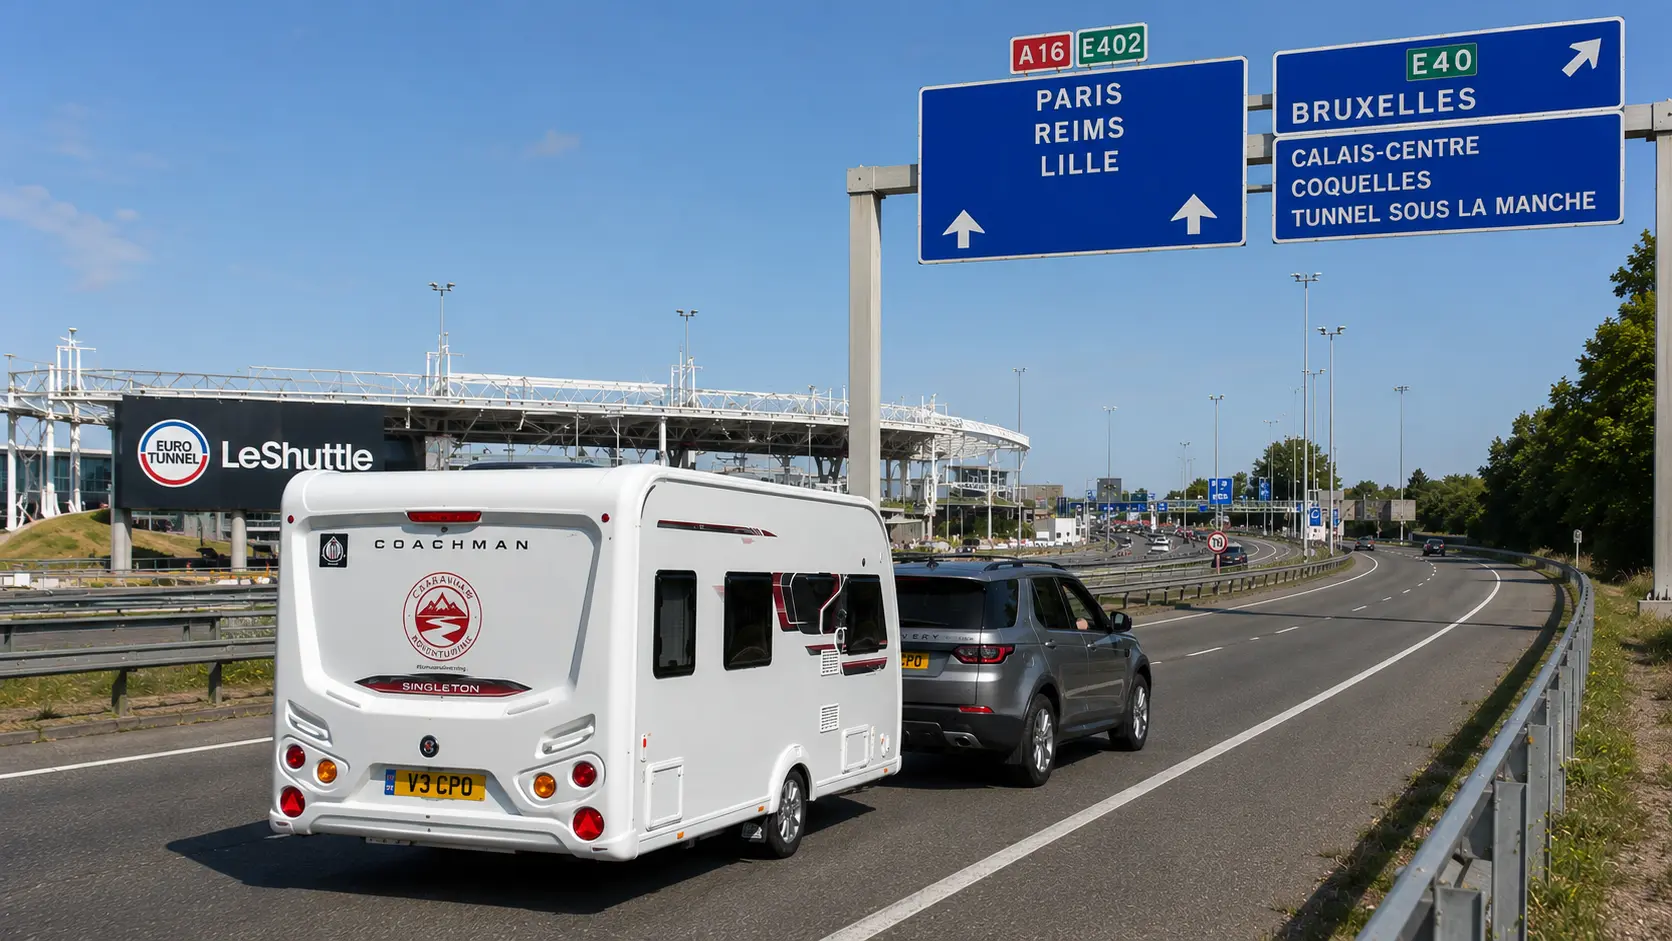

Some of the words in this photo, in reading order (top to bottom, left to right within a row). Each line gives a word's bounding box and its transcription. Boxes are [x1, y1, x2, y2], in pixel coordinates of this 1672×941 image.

[1019, 41, 1065, 66] A16
[1082, 32, 1142, 58] E402
[1412, 49, 1472, 75] E40
[1036, 82, 1123, 112] PARIS
[1292, 87, 1477, 124] BRUXELLES
[1034, 116, 1125, 145] REIMS
[1041, 150, 1119, 177] LILLE
[1291, 135, 1480, 168] CALAIS-CENTRE
[1291, 170, 1432, 198] COQUELLES
[1291, 204, 1381, 228] TUNNEL
[1388, 200, 1450, 222] SOUS
[1458, 198, 1487, 217] LA
[1495, 190, 1597, 216] MANCHE
[147, 452, 200, 465] TUNNEL
[156, 440, 192, 452] EURO
[221, 440, 374, 471] LeShuttle
[374, 539, 529, 550] COACHMAN
[402, 682, 480, 693] SINGLETON
[408, 772, 431, 794] V3
[436, 775, 473, 797] CPO
